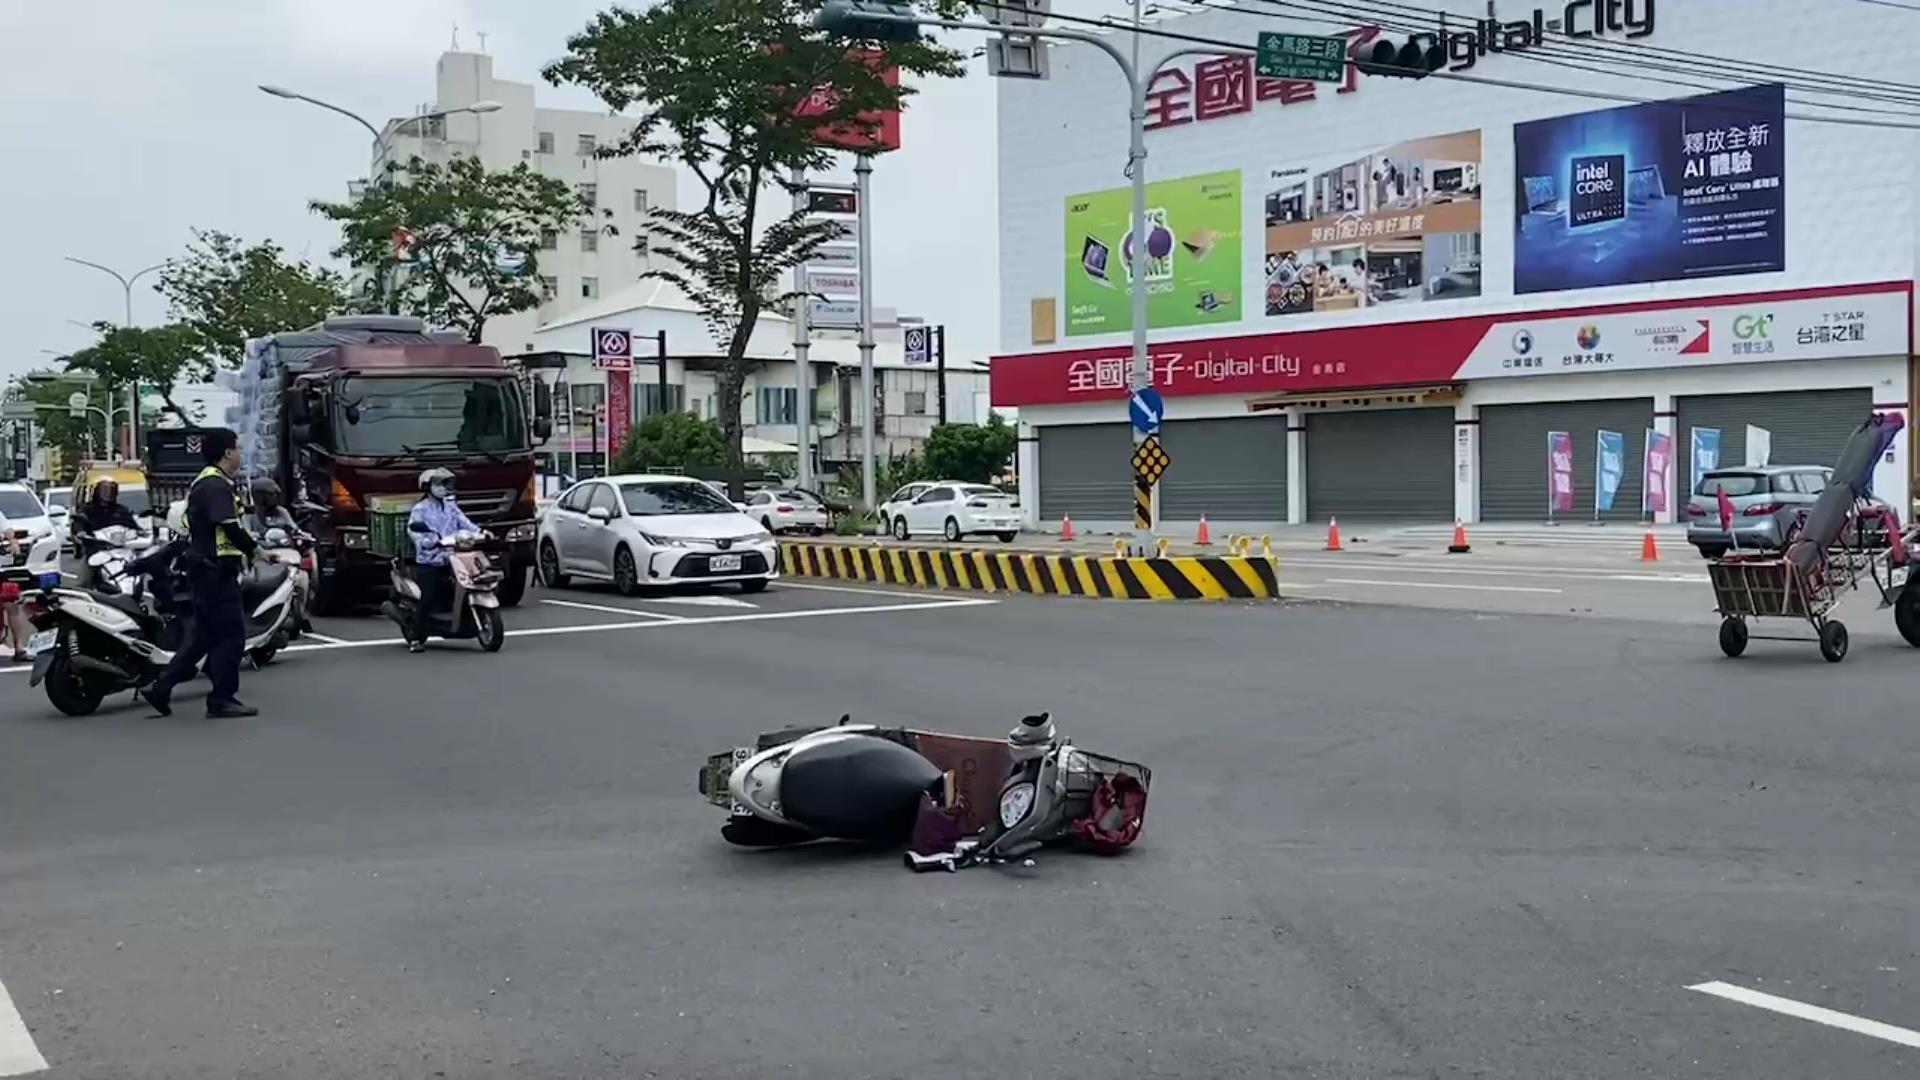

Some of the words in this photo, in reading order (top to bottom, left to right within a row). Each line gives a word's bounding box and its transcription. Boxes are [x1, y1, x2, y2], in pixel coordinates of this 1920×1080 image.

[1682, 123, 1770, 155] 釋放全新
[1576, 161, 1609, 181] intel
[1683, 158, 1705, 179] AI
[1709, 150, 1753, 177] 體驗
[1271, 167, 1309, 178] Panasonic
[1576, 209, 1603, 221] ULTRA
[815, 278, 855, 288] TOSHIBA
[1833, 311, 1865, 321] STAR
[1797, 323, 1865, 345] 台灣之星
[1732, 340, 1775, 355] 智慧生活
[1563, 352, 1614, 366] 台灣大哥大
